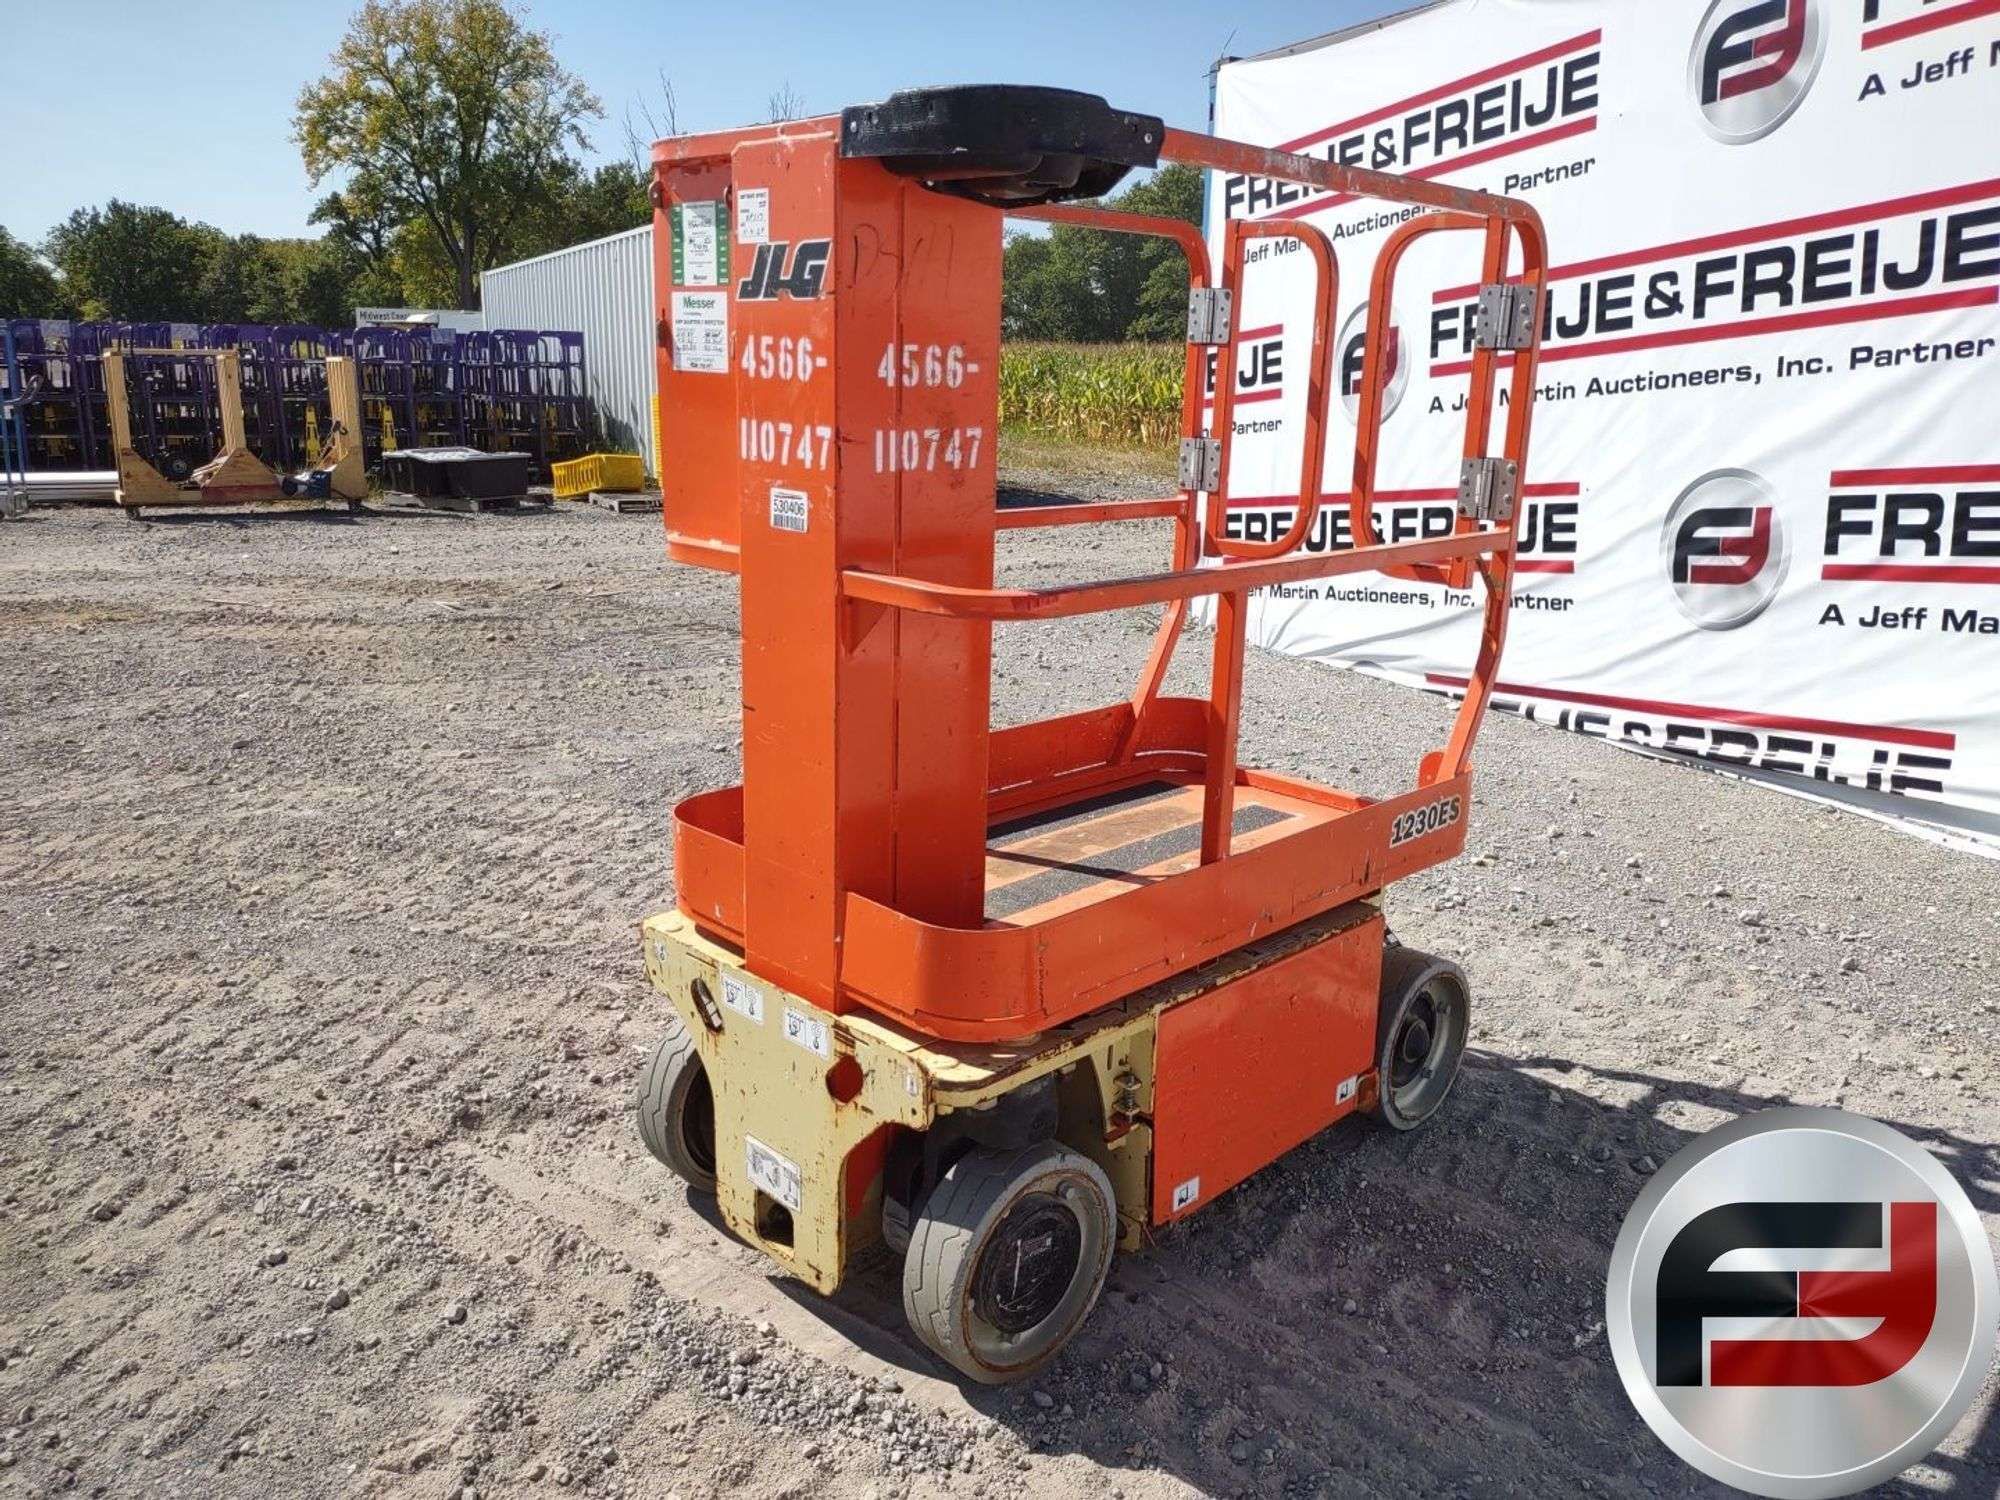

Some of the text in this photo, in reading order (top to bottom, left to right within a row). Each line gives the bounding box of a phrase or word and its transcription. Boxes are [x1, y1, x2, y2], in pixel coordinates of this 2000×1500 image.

[1858, 73, 1886, 102] A
[1900, 46, 1975, 89] Jeff
[1371, 128, 1398, 170] &
[1403, 52, 1600, 166] FREIJE
[1504, 157, 1596, 195] Partner
[738, 240, 832, 300] JLG
[1644, 270, 1684, 320] &
[1693, 207, 2000, 320] FREIJE
[742, 334, 828, 382] 4566-
[877, 342, 980, 389] 4566-
[1429, 395, 1444, 413] A
[1500, 382, 1575, 406] Mrtin
[1585, 362, 1761, 398] Auctioneers,
[1777, 354, 1834, 379] Inc.
[1849, 338, 1996, 371] Partner
[741, 418, 832, 471] 110747
[876, 427, 983, 473] 110747
[1270, 584, 1318, 600] Martin
[1325, 586, 1435, 608] Auctioneers,
[1444, 590, 1475, 607] Inc.
[1818, 604, 1845, 626] A
[1858, 606, 1927, 630] Jeff
[1391, 796, 1460, 845] 1230ES
